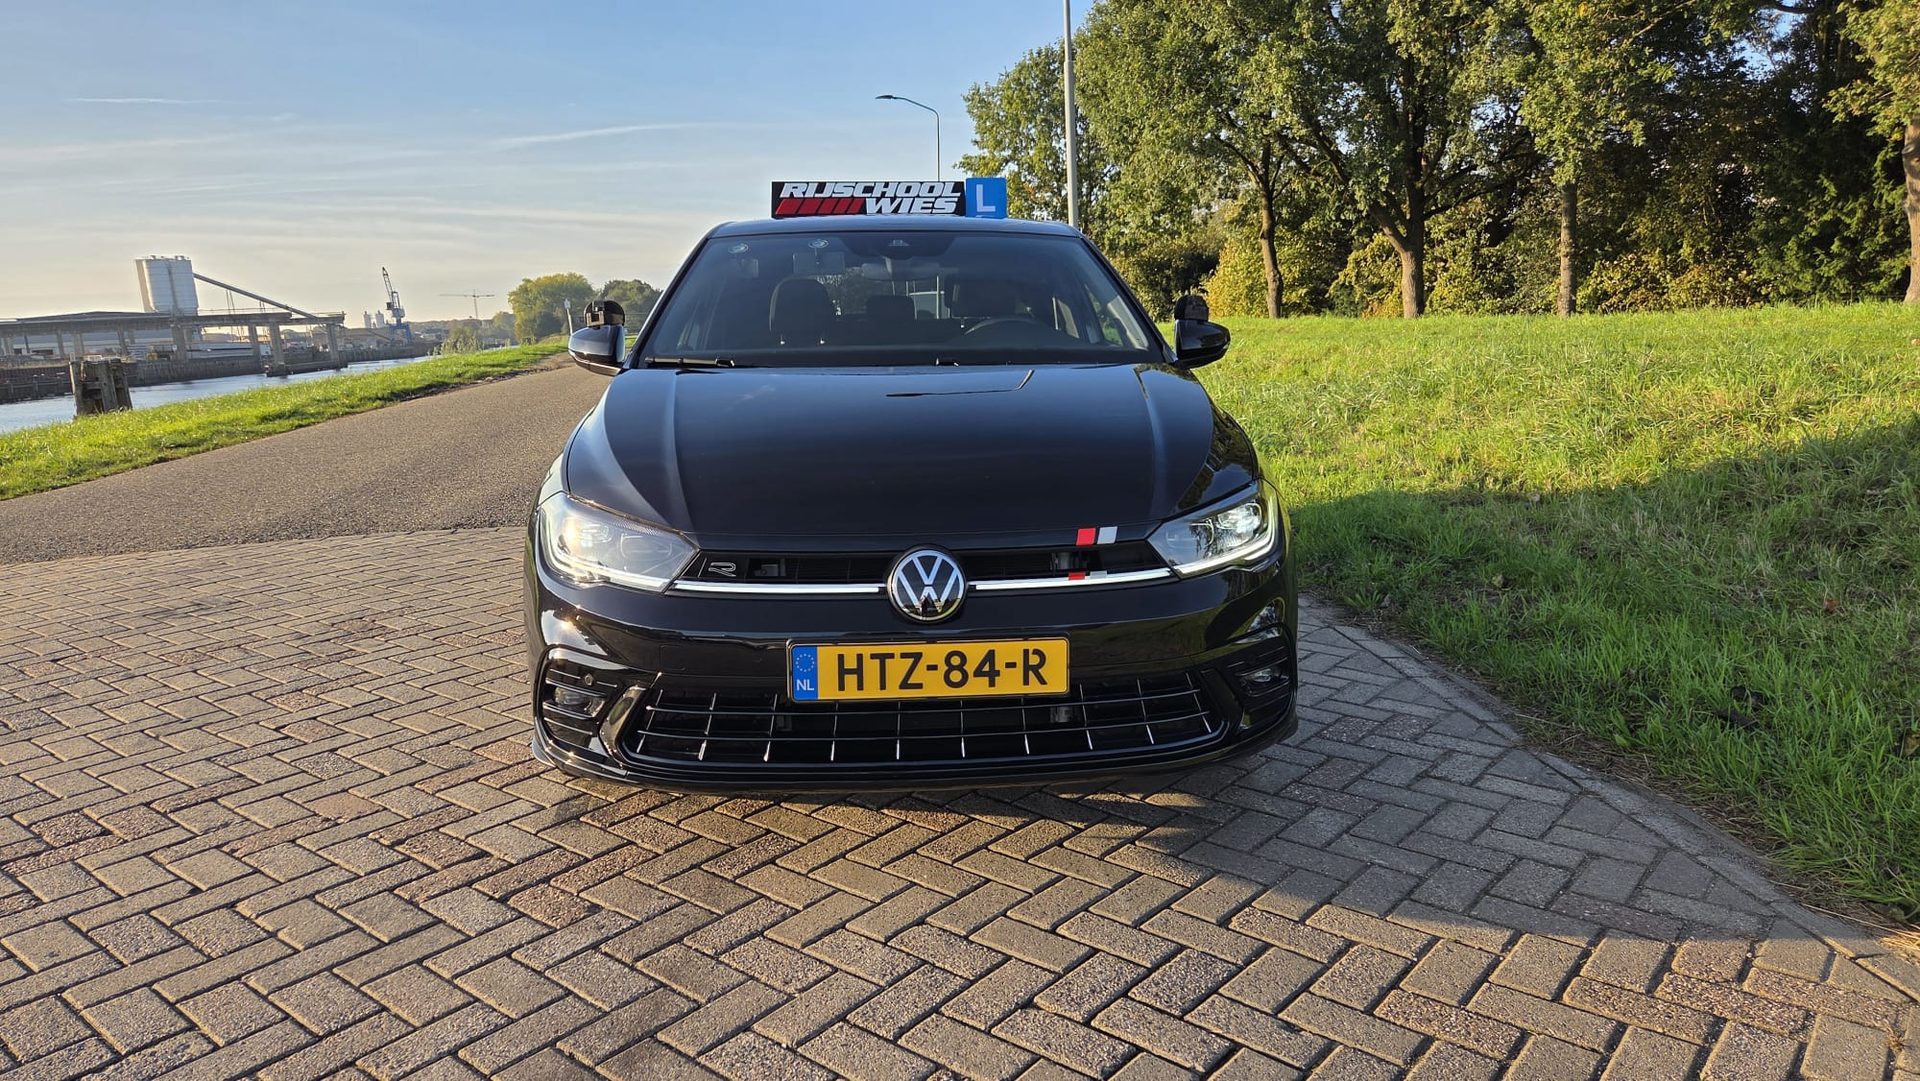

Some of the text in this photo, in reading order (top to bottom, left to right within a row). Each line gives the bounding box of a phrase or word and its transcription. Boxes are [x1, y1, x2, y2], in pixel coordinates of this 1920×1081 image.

[779, 182, 961, 198] RIJSCHOOL
[976, 184, 996, 212] L
[865, 198, 959, 214] WIES
[837, 648, 1048, 692] HTZ-84-R
[796, 679, 815, 691] NL
